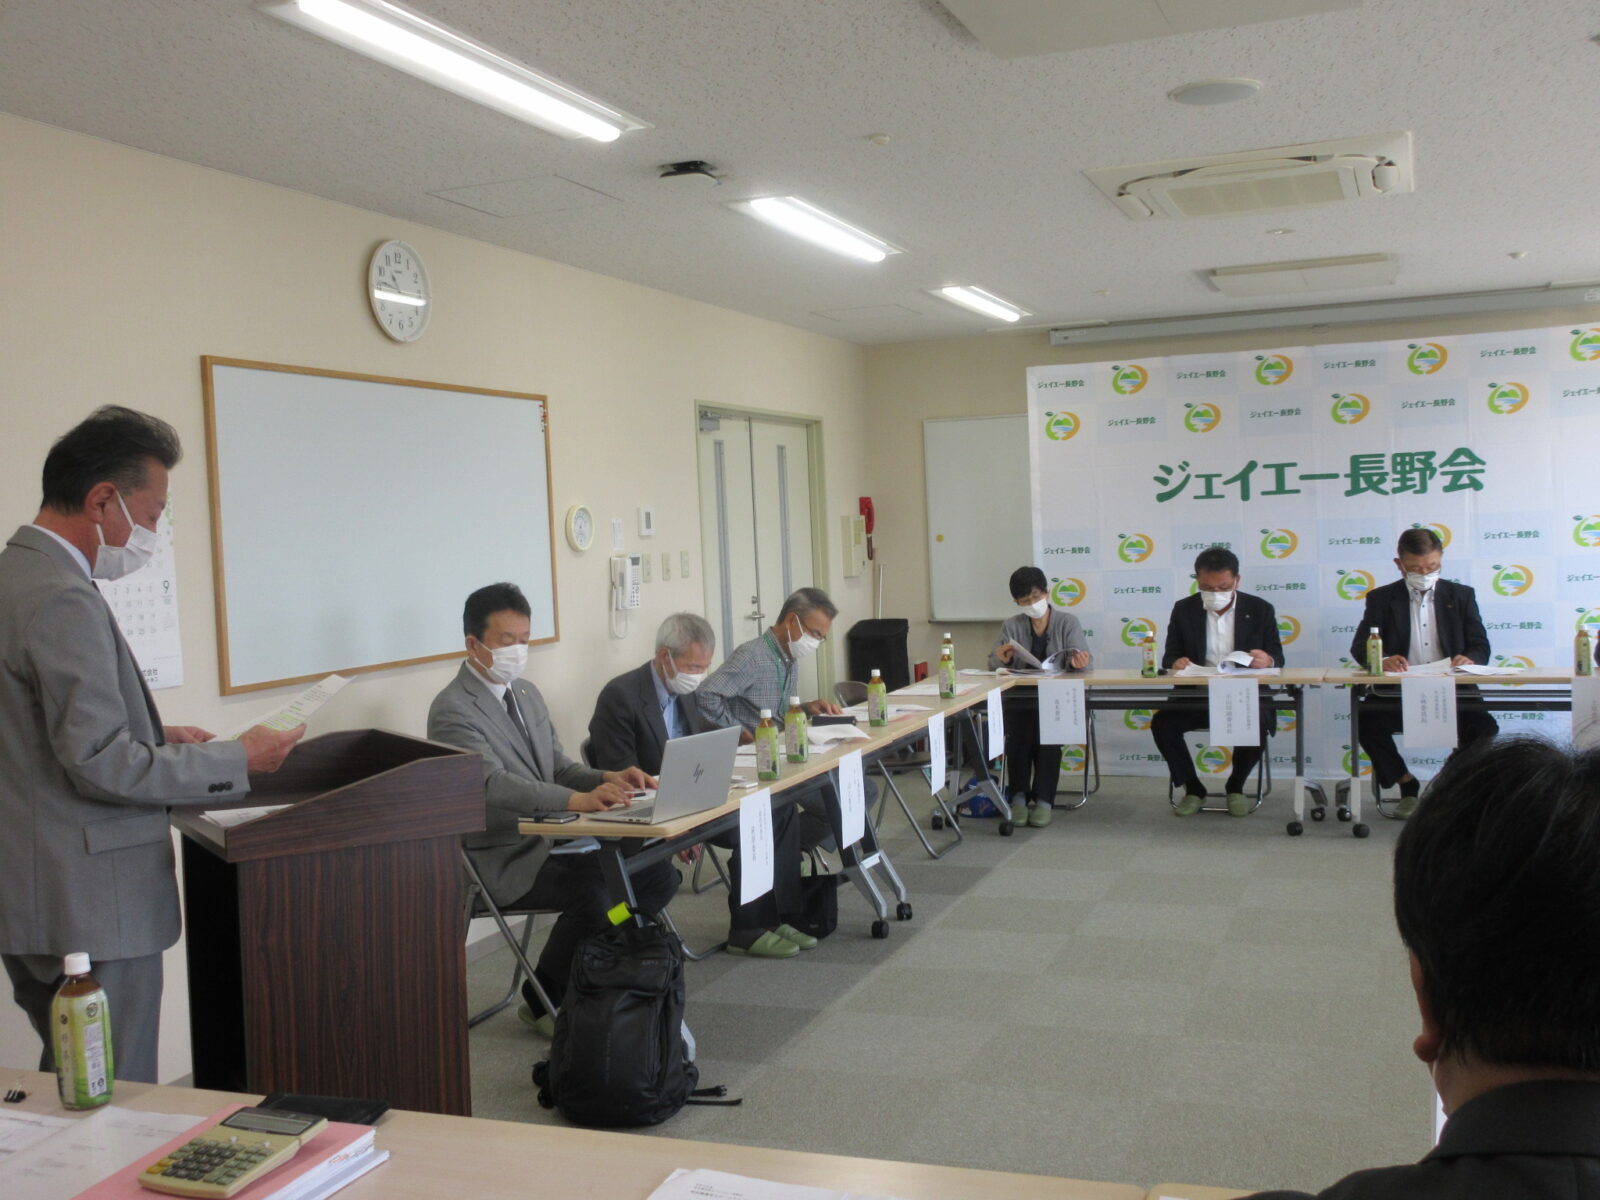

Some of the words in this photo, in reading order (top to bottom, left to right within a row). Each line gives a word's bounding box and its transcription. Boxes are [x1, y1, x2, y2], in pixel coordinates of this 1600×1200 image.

[394, 252, 402, 264] 12
[1480, 346, 1537, 358] ジェイエー長野会
[1323, 359, 1376, 370] ジェイエー長野会
[1176, 370, 1226, 379] ジェイエー長野会
[1401, 398, 1456, 409] ジェイエー長野会
[1107, 416, 1157, 427] ジェイエー長野会
[1153, 447, 1486, 503] ジェイエー長野会
[1483, 530, 1540, 540] ジェイエー長野会
[1328, 536, 1381, 546] ジェイエー長野会
[162, 580, 170, 594] 9
[1255, 581, 1307, 591] ジェイエー長野会
[1486, 621, 1543, 630] ジェイエー長野会
